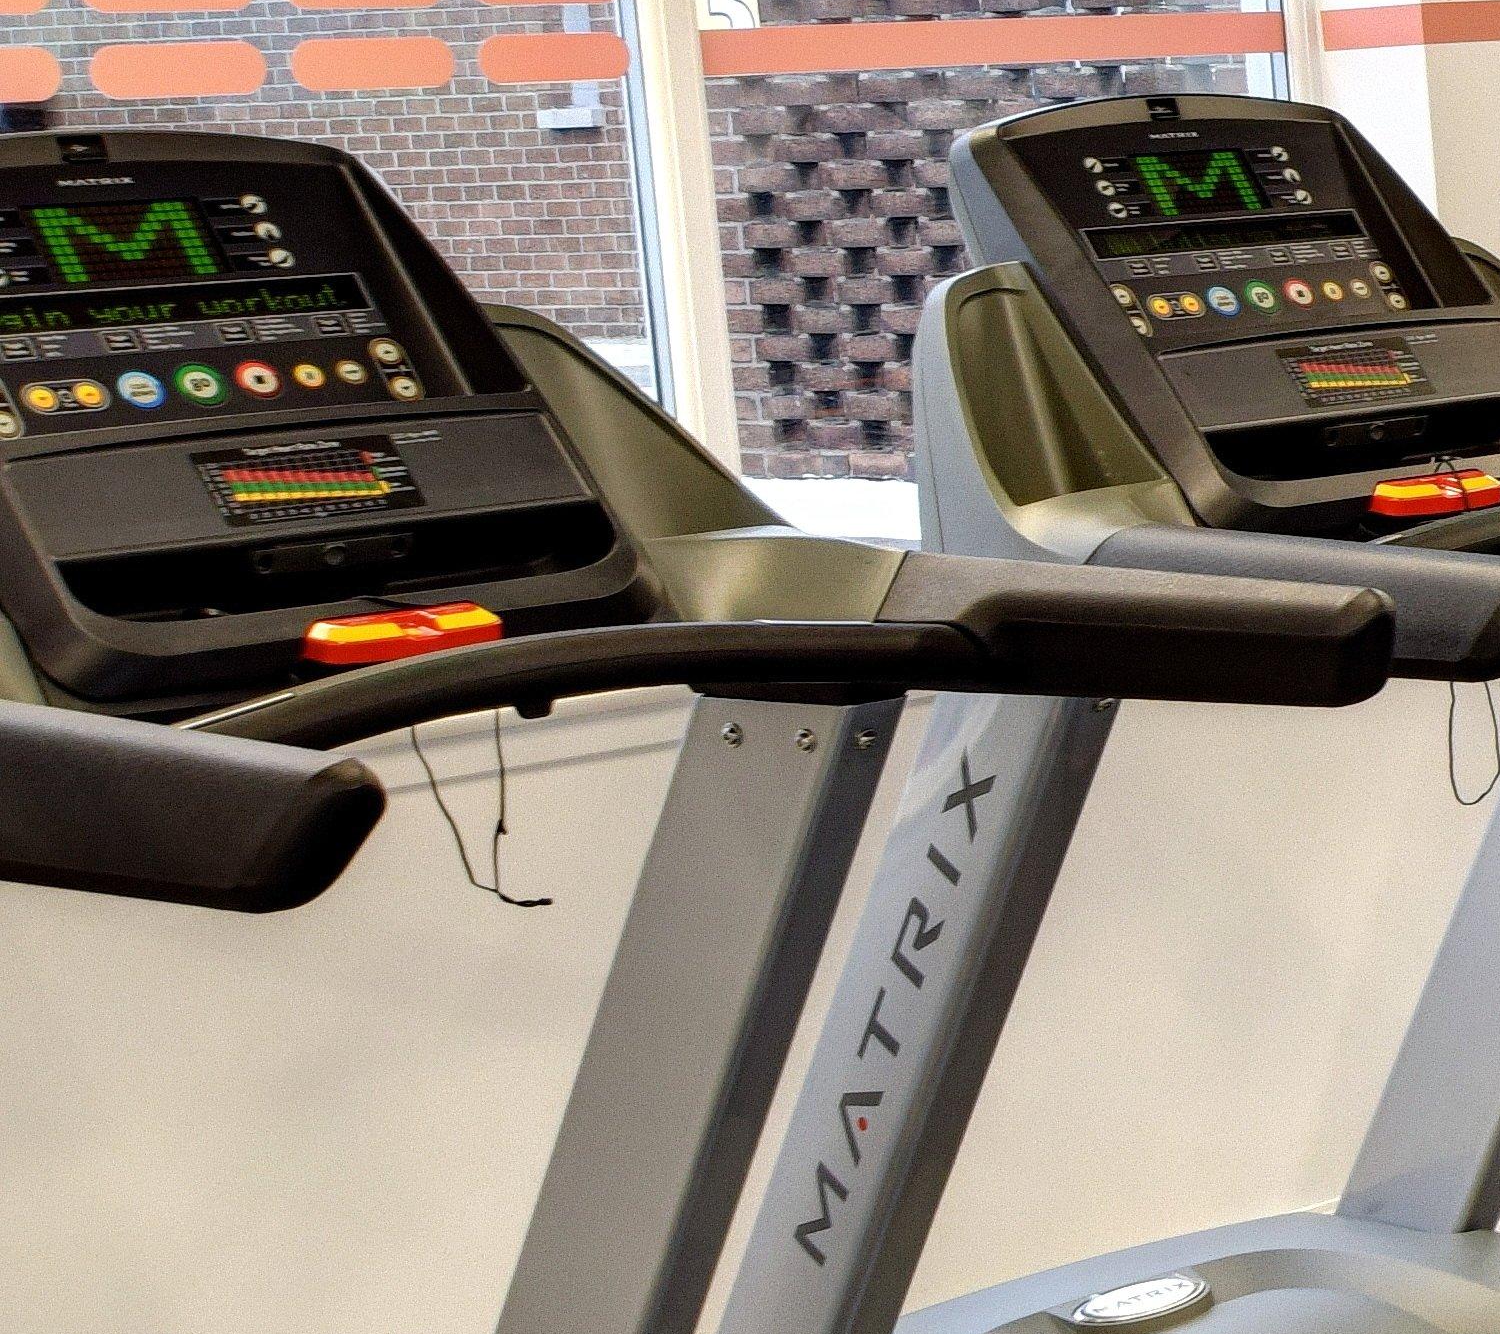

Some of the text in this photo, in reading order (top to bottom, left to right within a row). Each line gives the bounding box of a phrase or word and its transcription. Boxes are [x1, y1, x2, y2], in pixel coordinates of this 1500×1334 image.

[1136, 151, 1264, 217] M
[31, 200, 220, 284] M
[88, 304, 177, 325] your
[795, 745, 998, 1267] MATRIX
